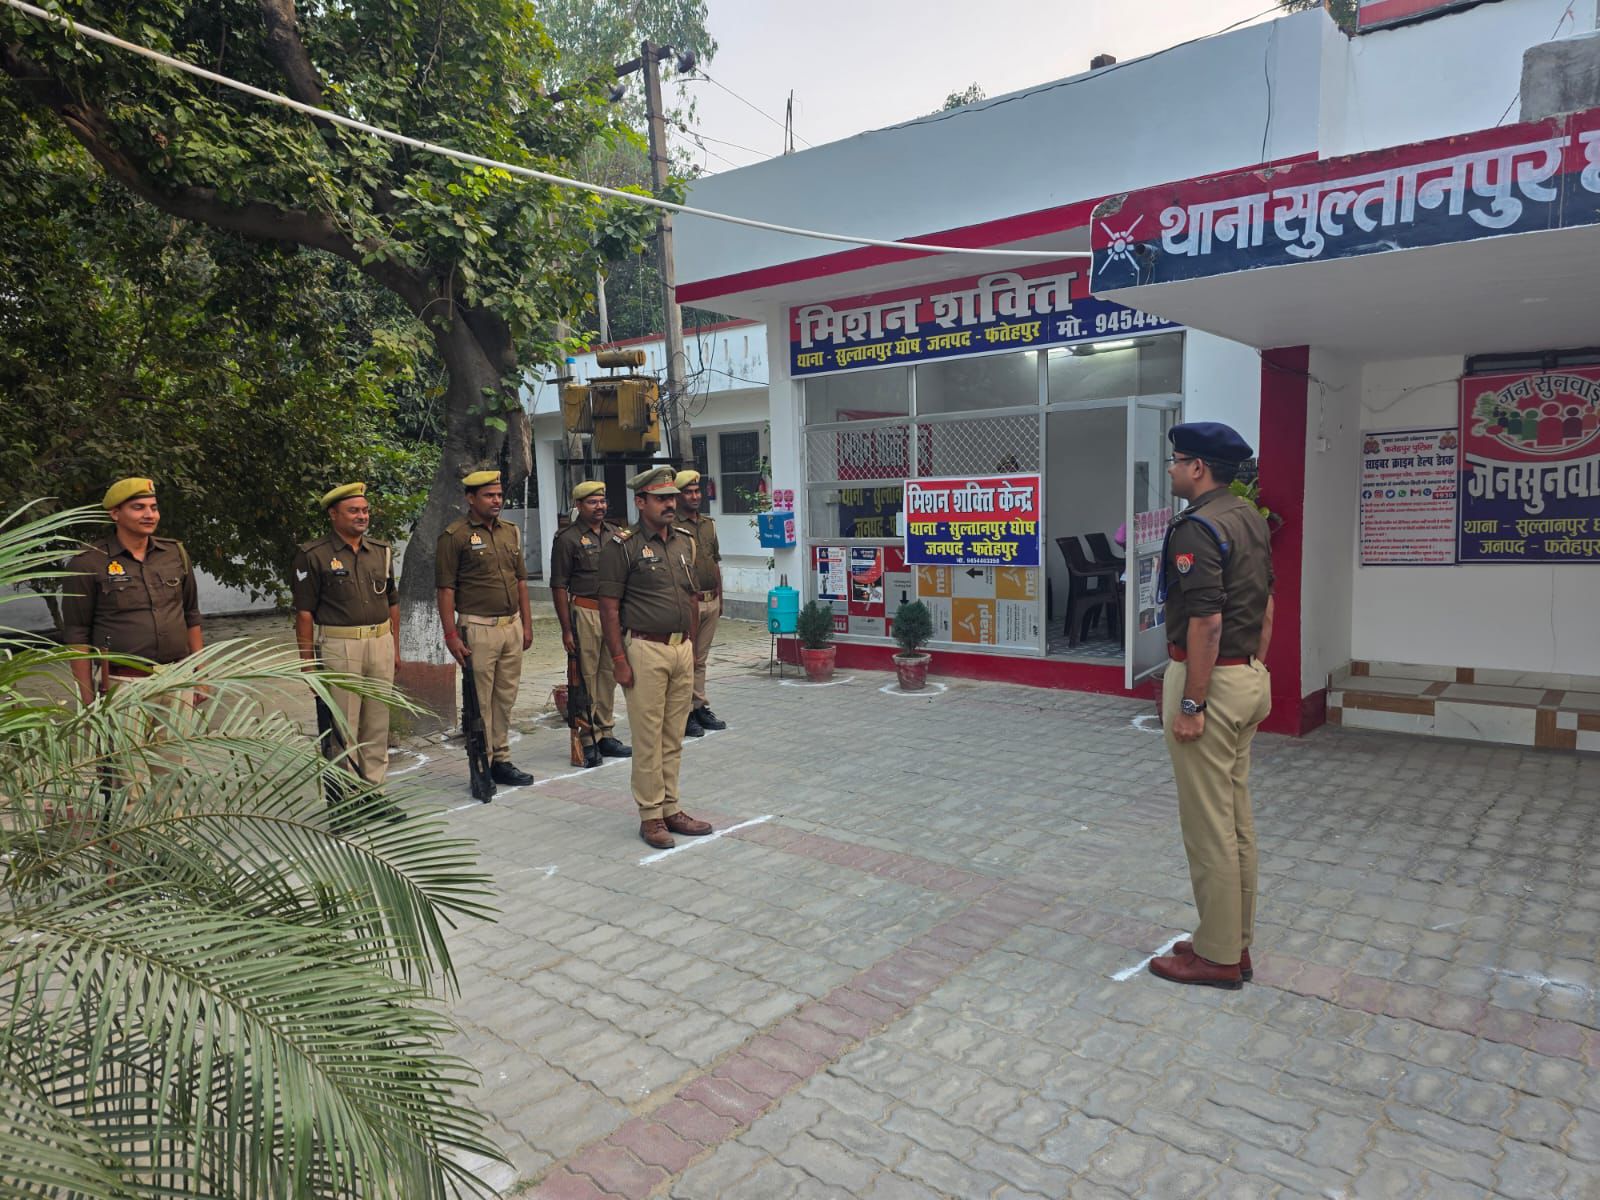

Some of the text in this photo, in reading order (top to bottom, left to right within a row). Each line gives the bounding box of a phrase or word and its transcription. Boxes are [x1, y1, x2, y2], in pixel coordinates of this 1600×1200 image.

[1160, 192, 1270, 256] थाना
[1273, 136, 1571, 258] सुल्तानपुर
[795, 298, 922, 349] मिशन
[930, 272, 1077, 328] शक्ति
[797, 351, 824, 368] थाना
[835, 342, 893, 366] सुल्तानपुर
[895, 336, 921, 355] घोष
[926, 330, 972, 350] जनपद
[984, 321, 1041, 343] फतेहपुर
[1497, 379, 1531, 404] जन
[1365, 453, 1455, 470] साइबर क्राइम हेल्प डेस्क
[908, 480, 1034, 513] मिशन शक्ति केन्द्र
[1465, 453, 1600, 515] जनसुनवा
[909, 522, 938, 536] थाना
[948, 521, 1007, 541] सुल्तानपुर
[1009, 517, 1036, 536] घोष
[1464, 519, 1498, 534] थाना
[1515, 518, 1589, 538] सुल्तानपुर
[924, 541, 964, 556] जनपद
[1479, 539, 1527, 554] जनपद
